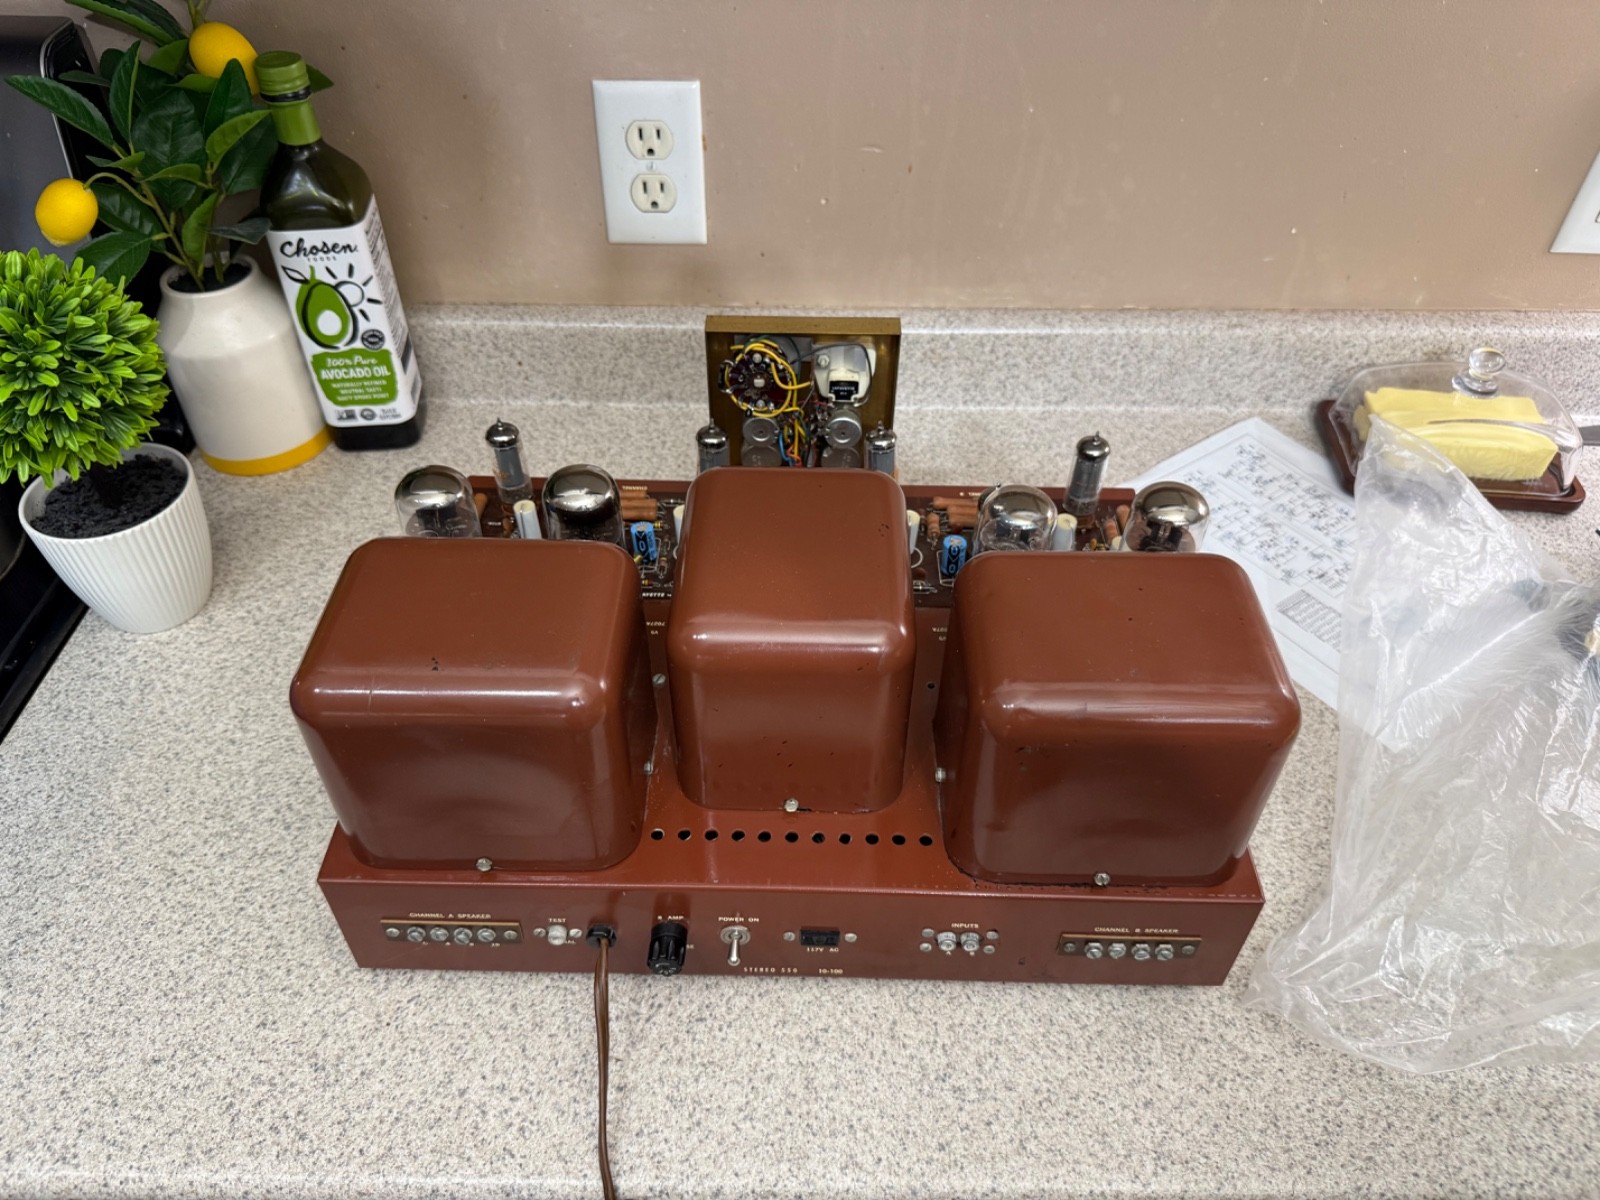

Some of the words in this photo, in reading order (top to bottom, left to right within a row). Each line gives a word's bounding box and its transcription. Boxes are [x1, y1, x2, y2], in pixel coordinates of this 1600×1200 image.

[280, 237, 357, 258] Chosen
[354, 355, 378, 365] Pure
[321, 367, 372, 380] AVOCADO
[373, 365, 391, 377] OIL
